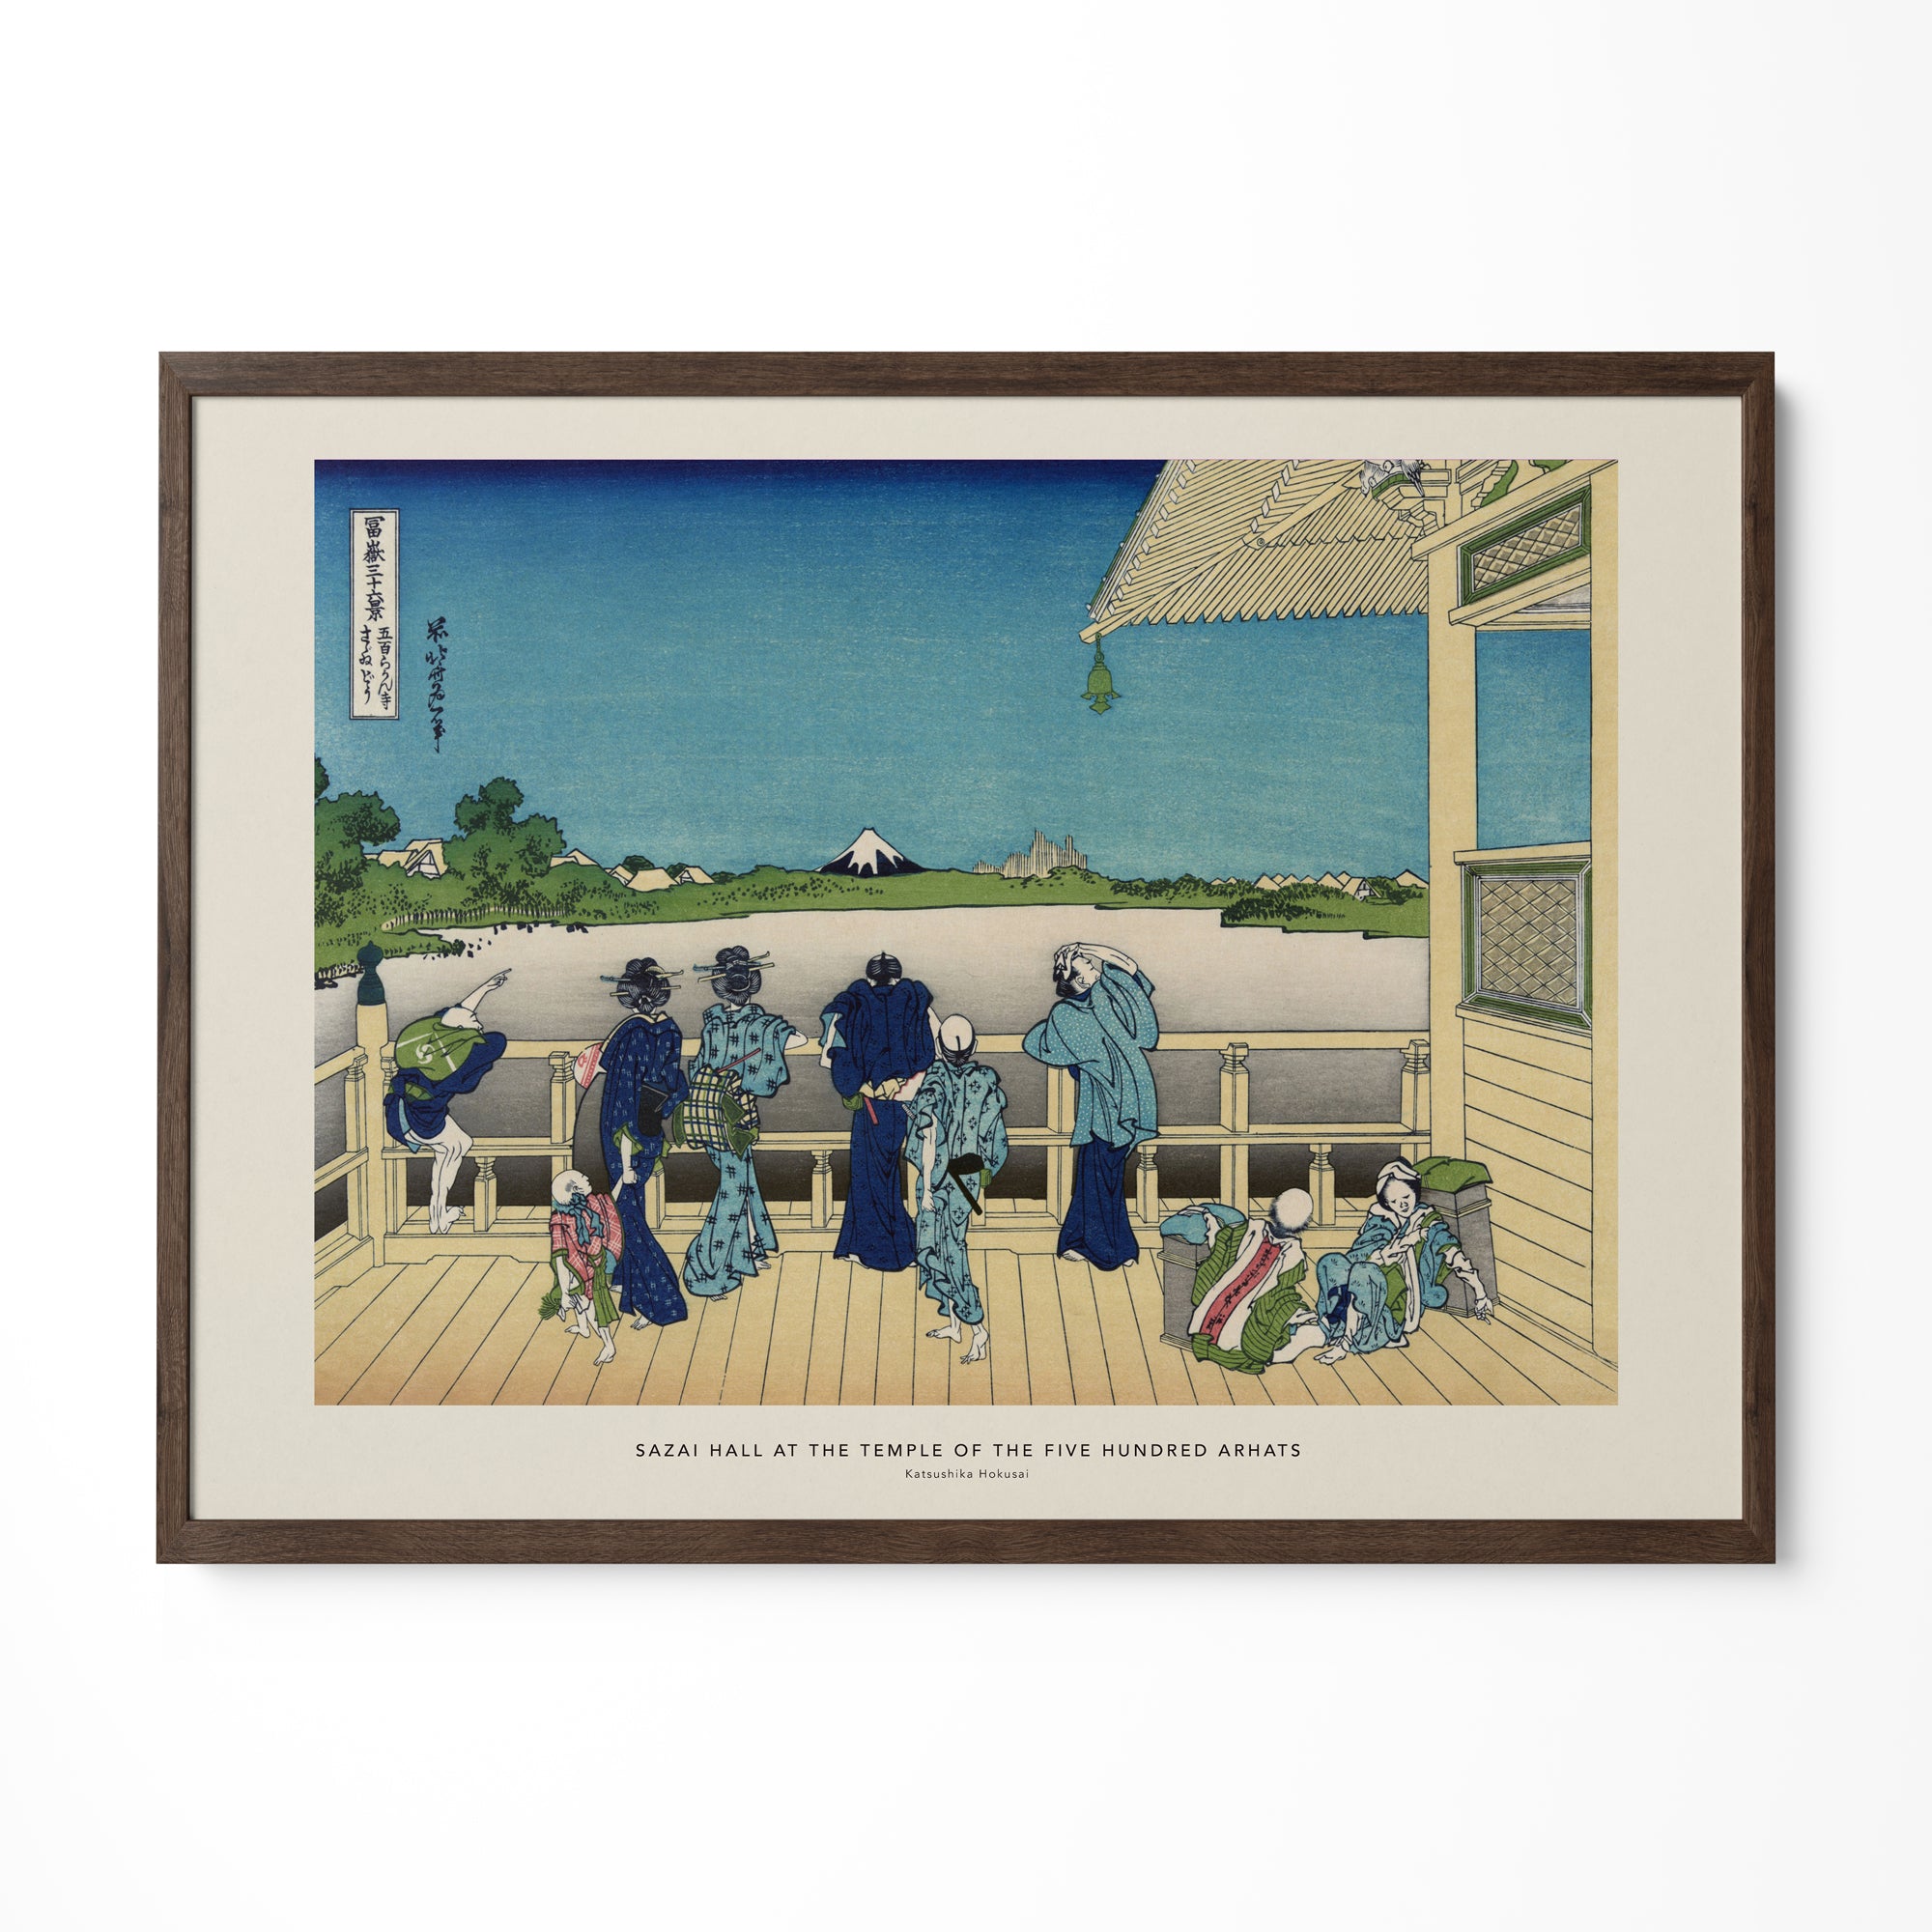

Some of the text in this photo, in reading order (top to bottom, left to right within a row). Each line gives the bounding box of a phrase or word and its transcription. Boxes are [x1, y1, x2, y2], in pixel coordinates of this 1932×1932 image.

[634, 1443, 1302, 1458] SAZAI HALL AT THE TEMPLE OF THE FIVE HUNDRED ARHATS
[905, 1468, 1029, 1479] Katsushika Hokusai
